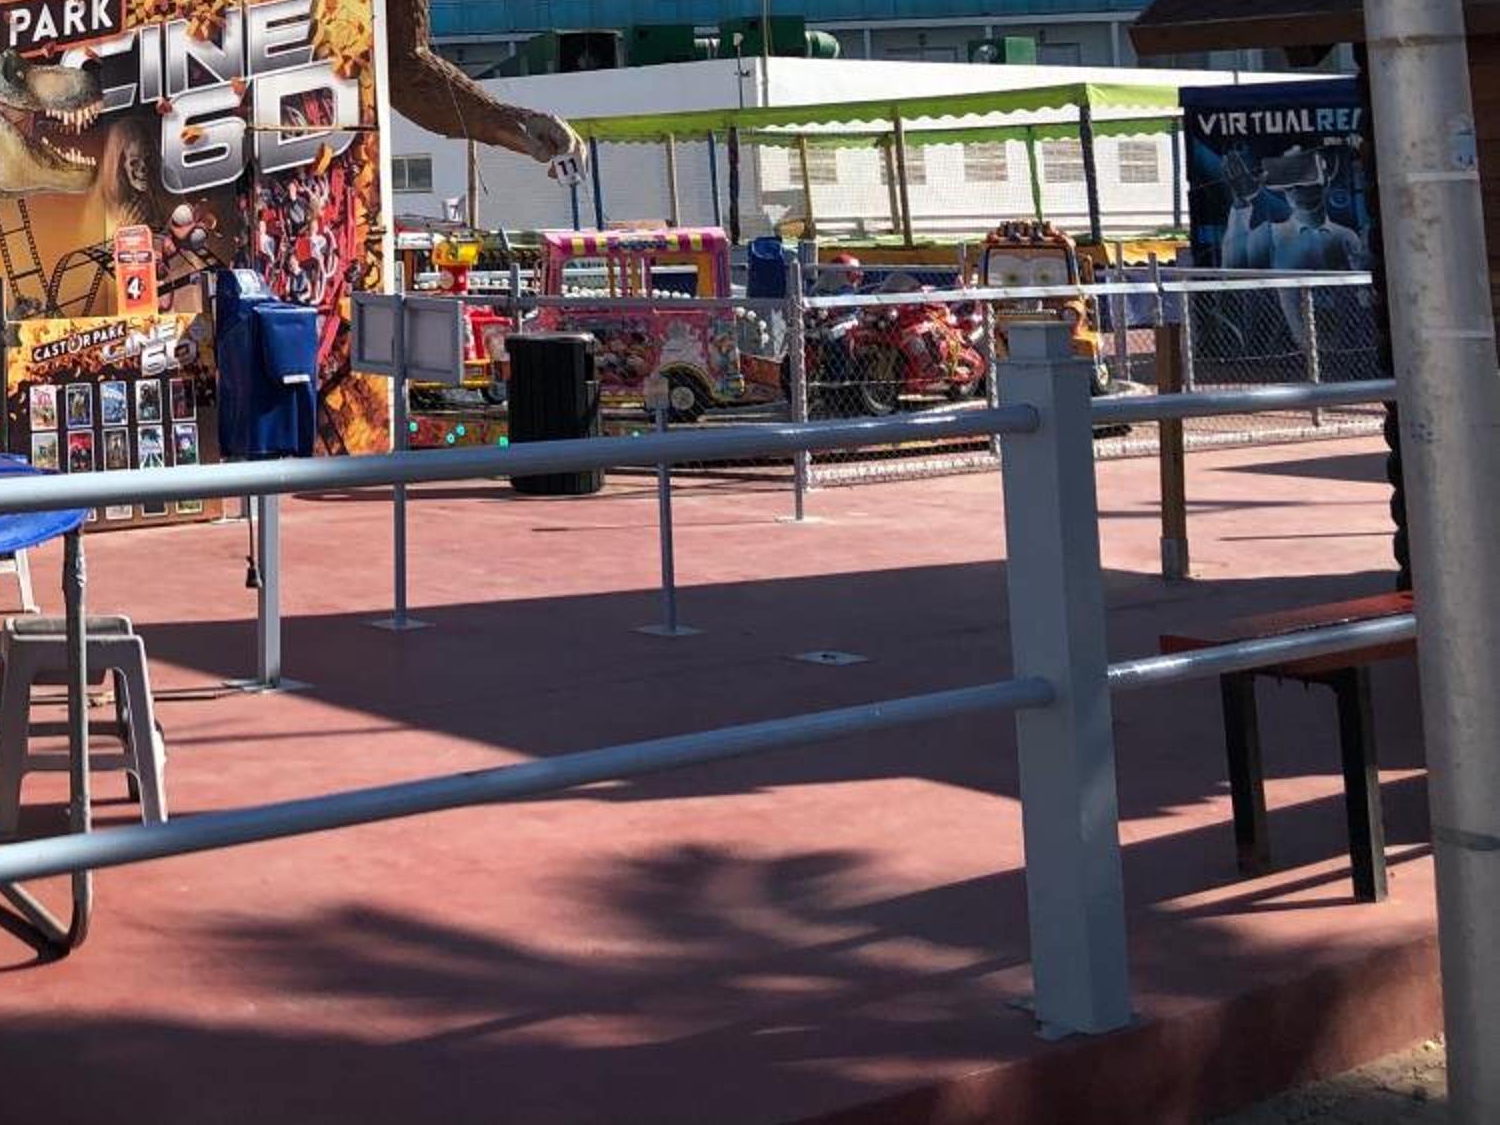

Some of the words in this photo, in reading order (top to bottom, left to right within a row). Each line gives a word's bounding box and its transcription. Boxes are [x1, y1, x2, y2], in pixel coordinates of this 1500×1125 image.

[161, 59, 361, 195] 6D
[557, 158, 578, 176] 11
[93, 323, 125, 344] PARK
